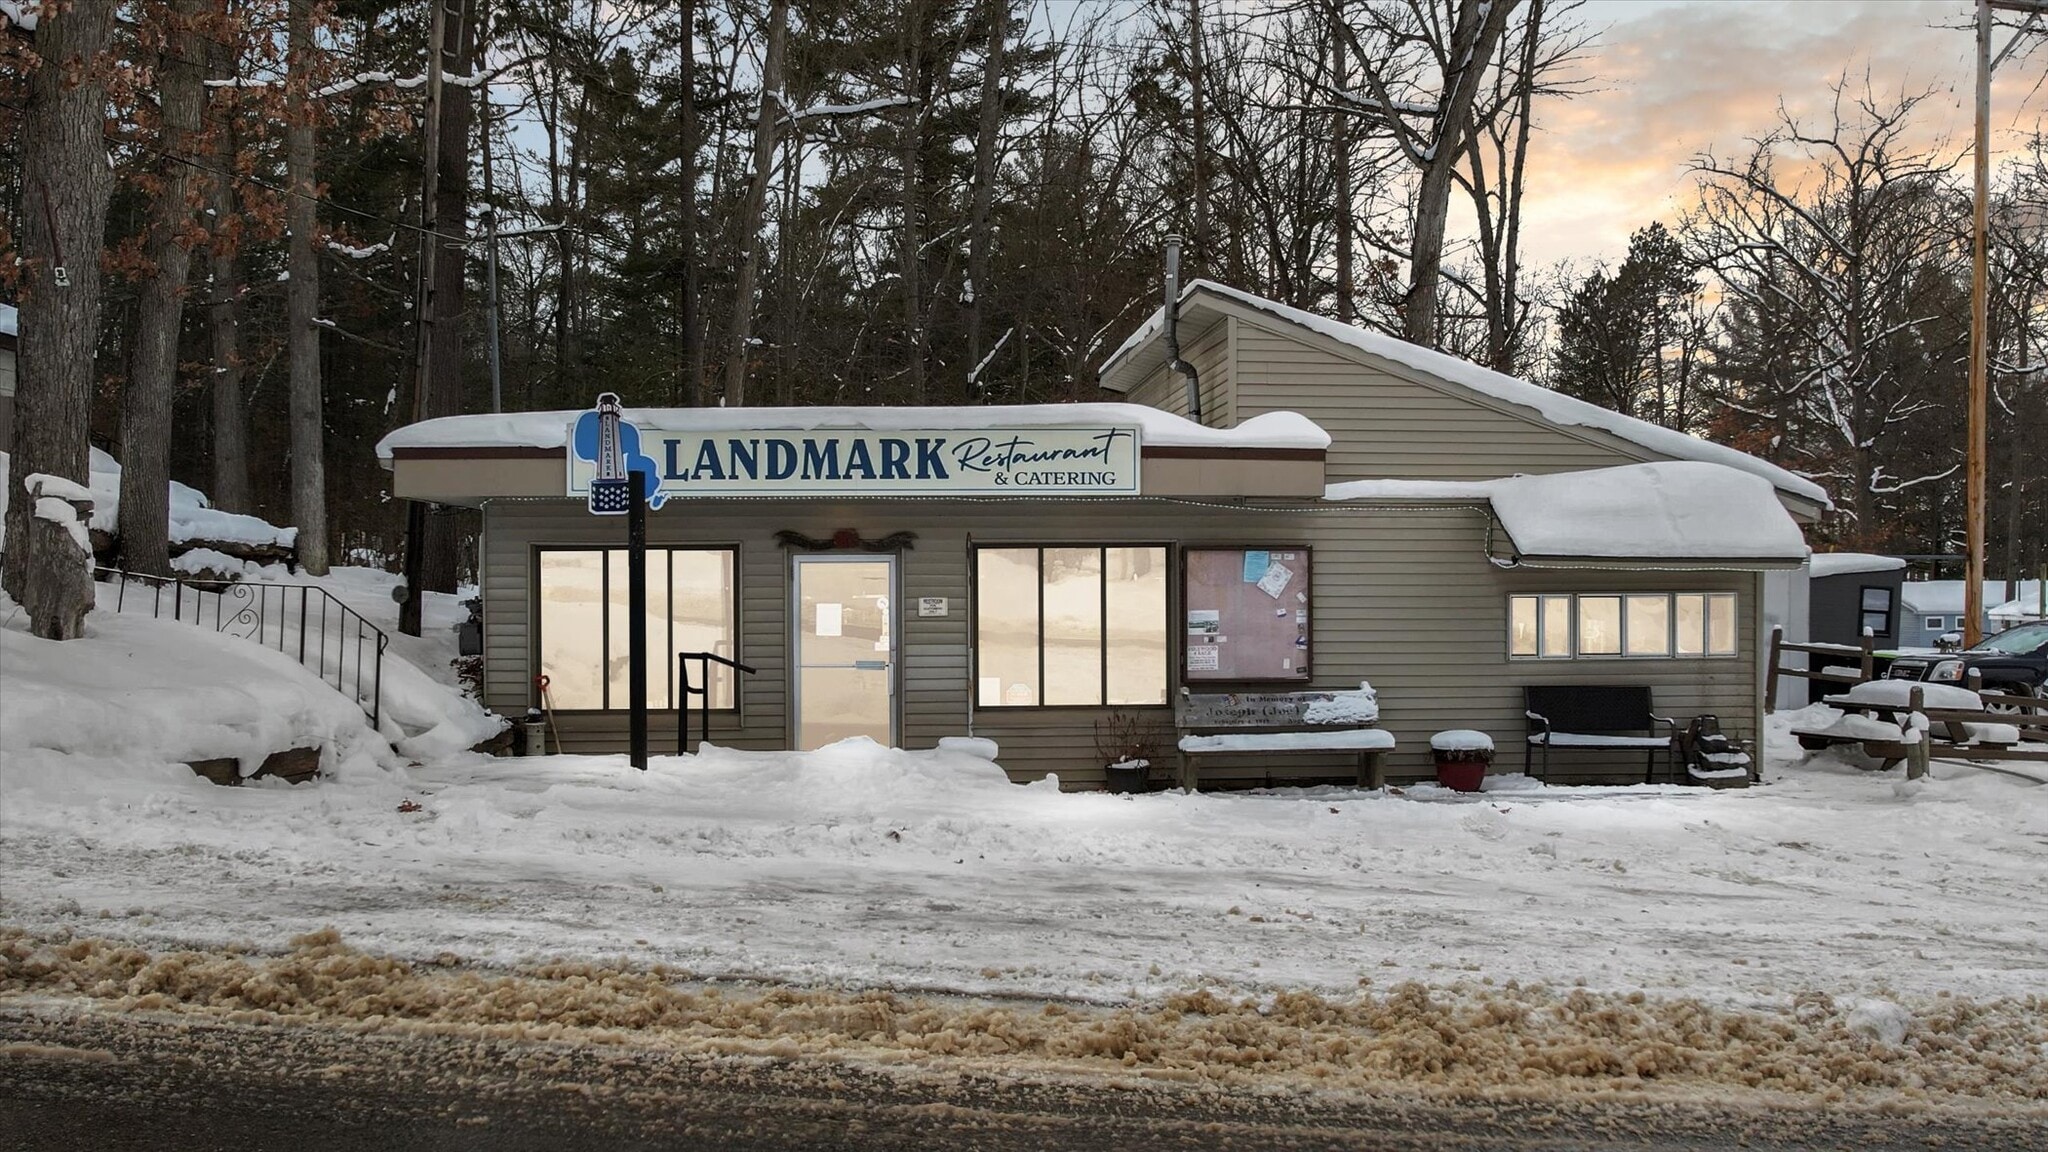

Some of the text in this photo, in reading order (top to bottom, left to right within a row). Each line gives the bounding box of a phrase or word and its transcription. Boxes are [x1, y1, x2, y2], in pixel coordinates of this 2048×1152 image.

[604, 421, 612, 472] LANDMARK
[663, 427, 1132, 482] LANDMARK Restaurant
[994, 471, 1116, 486] & CATERING
[1246, 695, 1256, 703] In
[1260, 695, 1293, 704] Memory
[1206, 707, 1256, 718] Joseph
